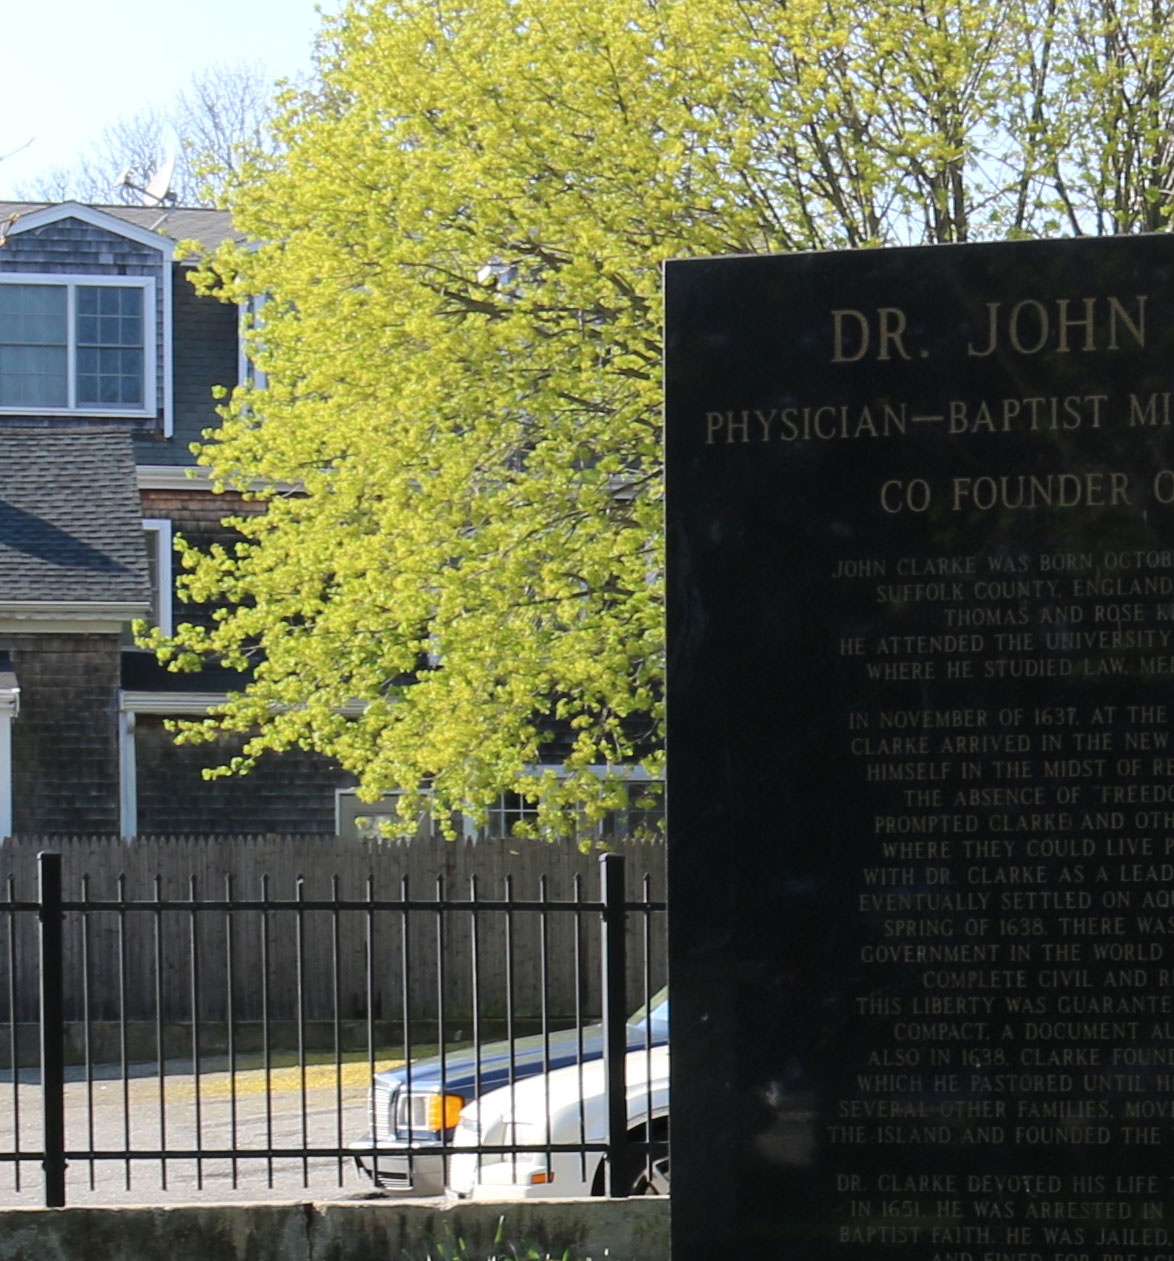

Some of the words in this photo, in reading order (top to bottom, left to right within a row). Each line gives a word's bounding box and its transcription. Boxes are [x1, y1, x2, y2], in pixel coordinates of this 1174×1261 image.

[830, 308, 929, 363] DR.
[967, 295, 1148, 357] JOHN
[880, 478, 931, 513] CO
[952, 472, 1133, 511] FOUNDER
[832, 558, 885, 578] JOHN
[896, 555, 976, 576] CLARKE
[1040, 552, 1094, 572] BORN
[876, 582, 963, 603] SUFFOLK
[944, 606, 1029, 627] THOMAS
[1094, 603, 1143, 623] ROSE
[876, 634, 983, 655] ATTENDED
[1045, 629, 1170, 651] UNIVERSITY
[867, 660, 935, 680] WHERE
[984, 657, 1074, 678] STUDIED
[879, 709, 987, 729] NOVEMBER
[850, 736, 928, 755] CLARKE
[940, 734, 1030, 754] ARRIVED
[867, 761, 950, 782] HIMSELF
[1043, 759, 1105, 779] MIDST
[954, 786, 1045, 806] ABSENCE
[875, 814, 978, 834] PROMPTED
[988, 812, 1068, 833] CLARKE
[882, 840, 951, 859] WHERE
[961, 839, 1015, 858] THEY
[1026, 838, 1095, 857] COULD
[1106, 838, 1152, 856] LIVE
[863, 867, 914, 886] WITH
[967, 865, 1046, 885] CLARKE
[858, 892, 989, 912] EVENTUALLY
[1000, 891, 1091, 911] SETTLED
[883, 918, 953, 937] SPRING
[1058, 917, 1125, 936] THERE
[860, 944, 999, 964] GOVERNMENT
[1093, 942, 1163, 962] WORLD
[922, 970, 1026, 989] COMPLETE
[1038, 969, 1092, 988] CIVIL
[856, 996, 901, 1015] THIS
[912, 996, 994, 1015] LIBERTY
[1025, 1022, 1139, 1040] DOCUMENT
[867, 1049, 919, 1067] ALSO
[1020, 1048, 1100, 1067] CLARKE
[857, 1074, 922, 1092] WHICH
[970, 1074, 1072, 1093] PASTORED
[1083, 1074, 1145, 1093] UNTIL
[838, 1100, 929, 1119] SEVERAL
[939, 1100, 1005, 1119] OTHER
[877, 1126, 951, 1145] ISLAND
[1015, 1127, 1110, 1145] FOUNDED
[877, 1174, 956, 1193] CLARKE
[967, 1175, 1061, 1194] DEVOTED
[1115, 1176, 1158, 1195] LIFE
[1025, 1201, 1131, 1220] ARRESTED
[839, 1226, 921, 1245] BAPTIST
